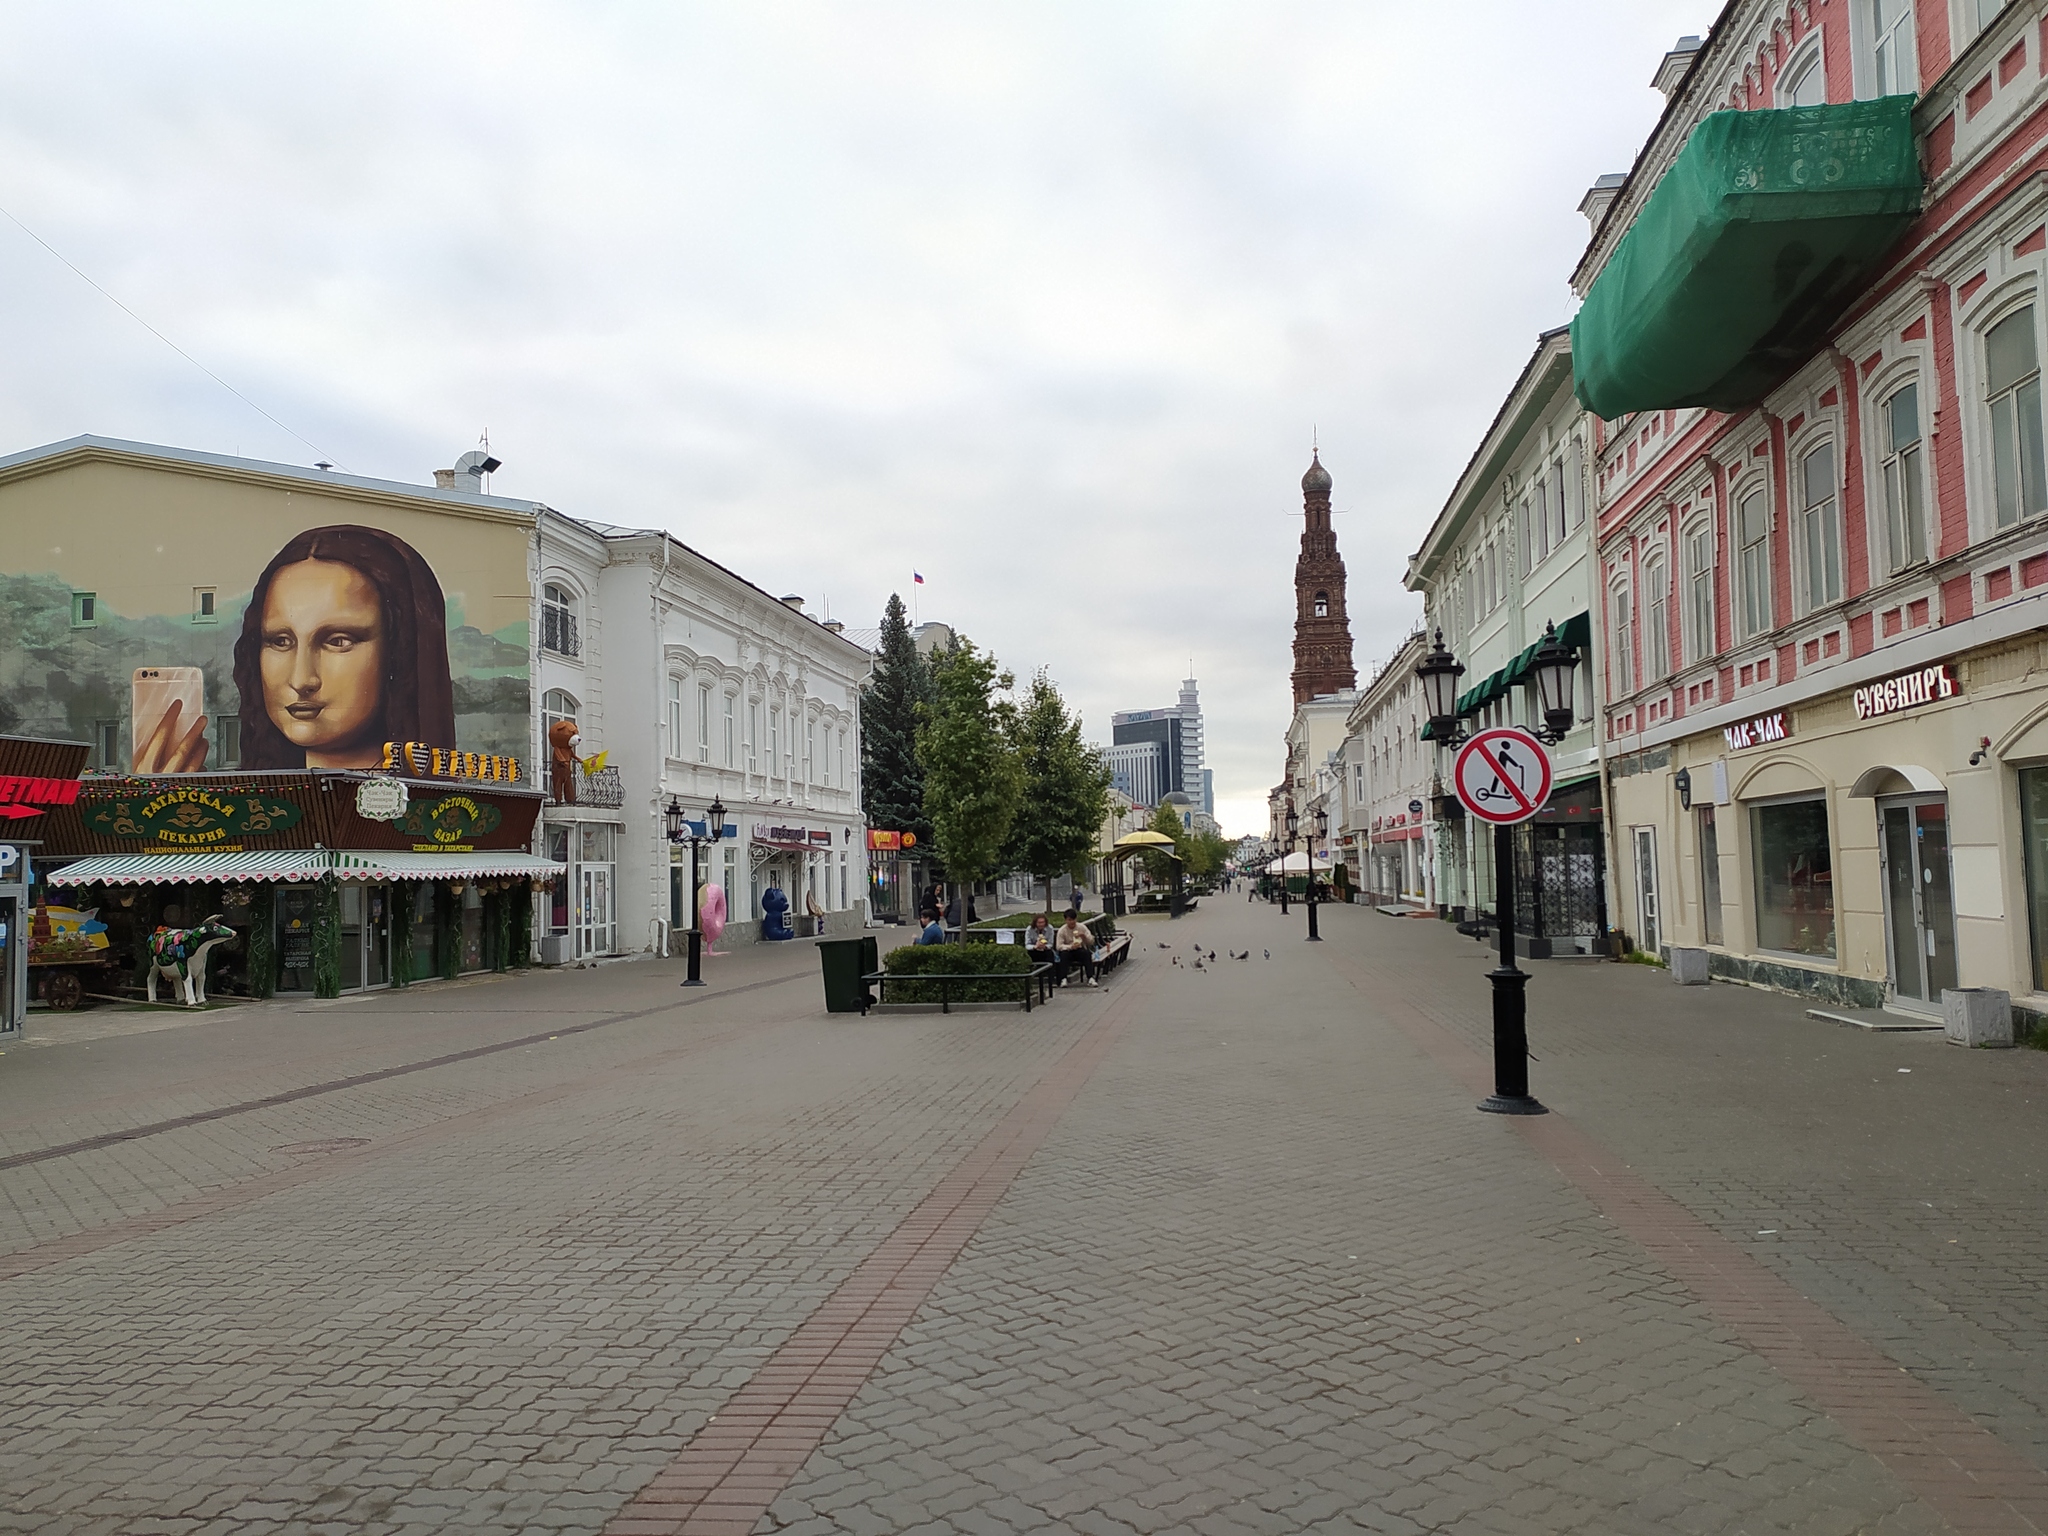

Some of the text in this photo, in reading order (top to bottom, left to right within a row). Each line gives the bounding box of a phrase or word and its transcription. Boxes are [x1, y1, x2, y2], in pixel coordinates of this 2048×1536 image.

[1854, 665, 1953, 719] СУВЕНИРЪ
[1724, 713, 1786, 749] ЧАК-ЧАК
[383, 742, 523, 782] Я КАЗАНЬ
[141, 791, 236, 818] ТАТАРСКАЯ
[431, 796, 479, 821] ВОСТОЧНЫЙ
[158, 827, 226, 843] ПЕКАРНЯ
[434, 828, 463, 843] БАЗАР
[144, 846, 211, 854] НАЦИОНАЛЬНАЯ
